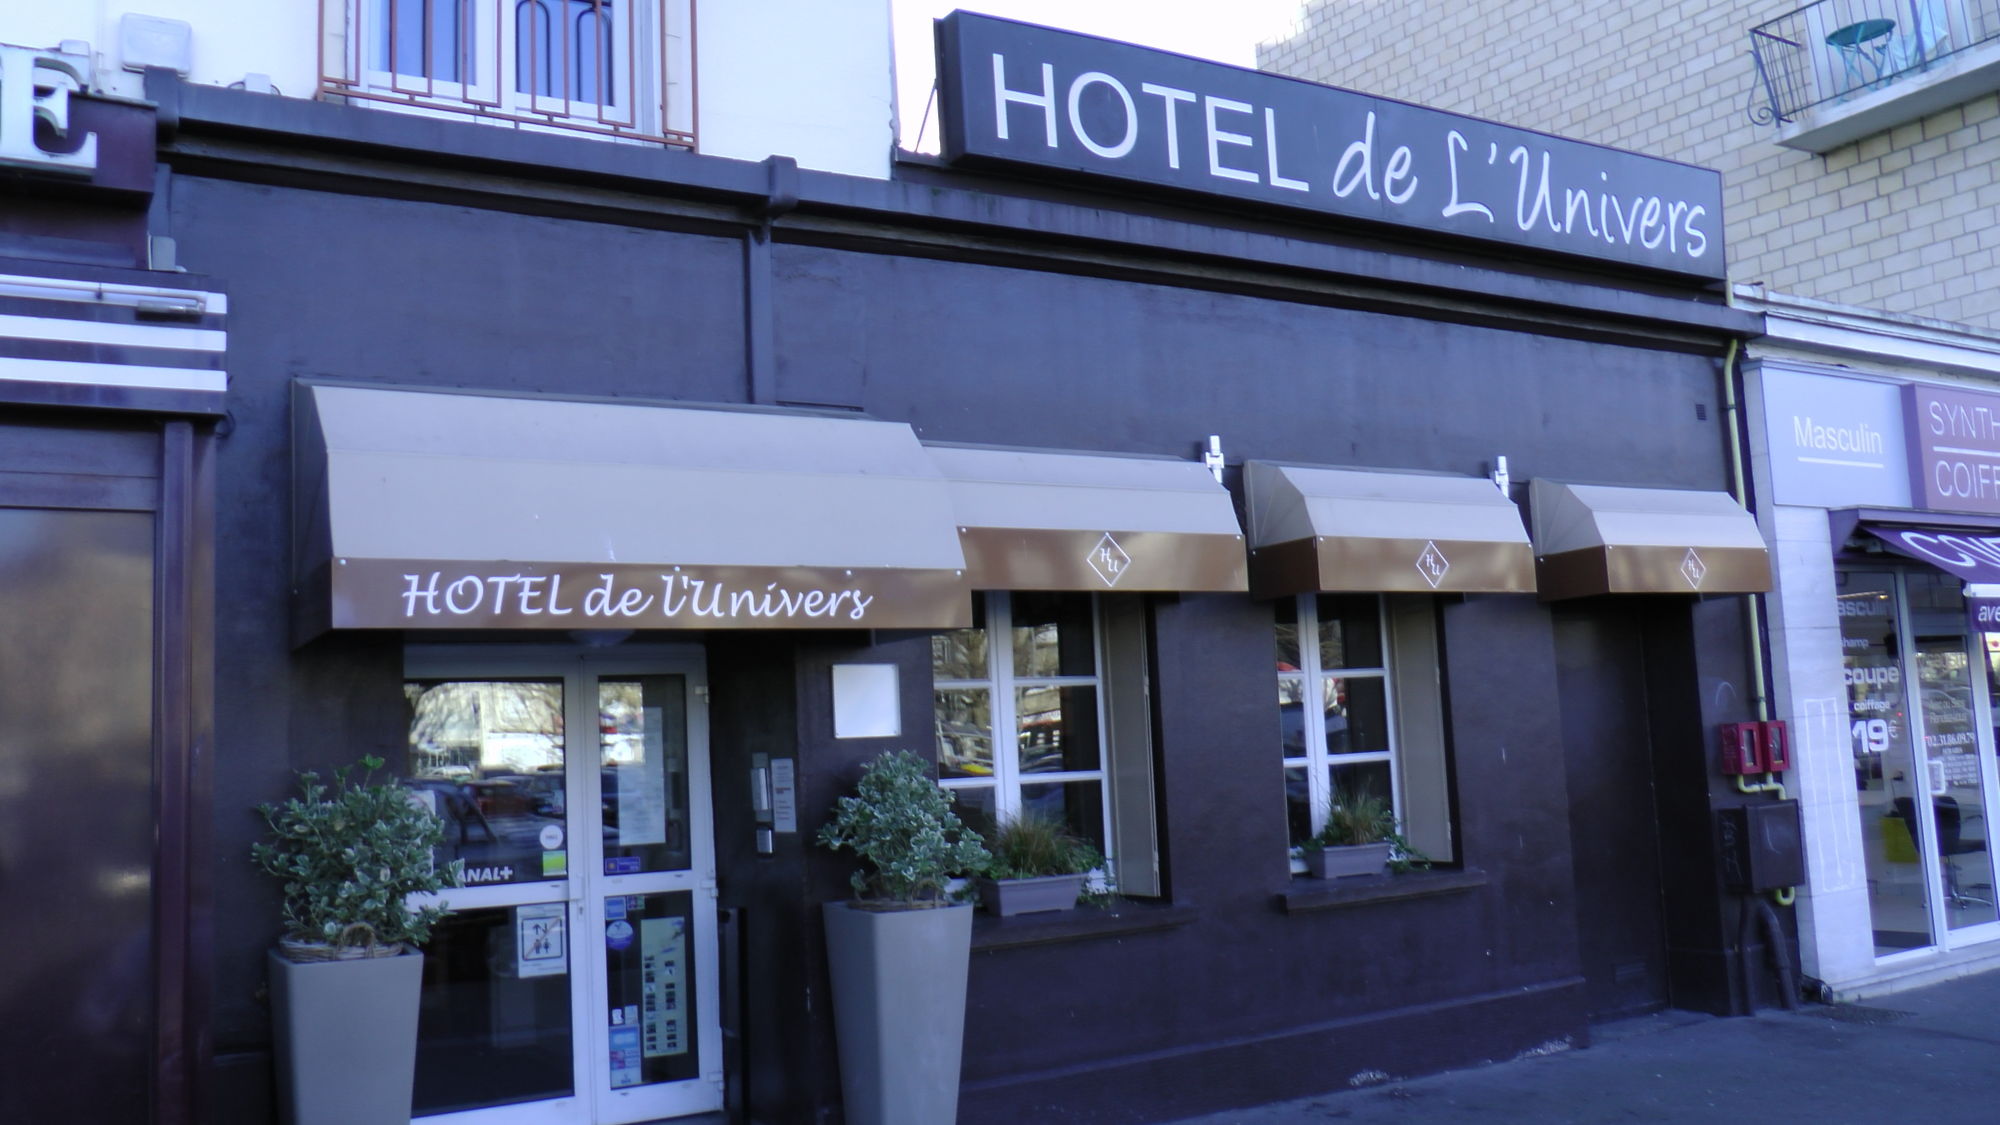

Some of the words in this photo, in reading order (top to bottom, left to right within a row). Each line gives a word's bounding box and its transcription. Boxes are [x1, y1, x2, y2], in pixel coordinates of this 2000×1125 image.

[992, 52, 1310, 192] HOTEL
[1333, 111, 1418, 204] de
[1441, 130, 1707, 257] L'Univers
[1793, 415, 1882, 454] Masculin
[402, 571, 573, 616] HOTEL
[584, 572, 653, 618] de
